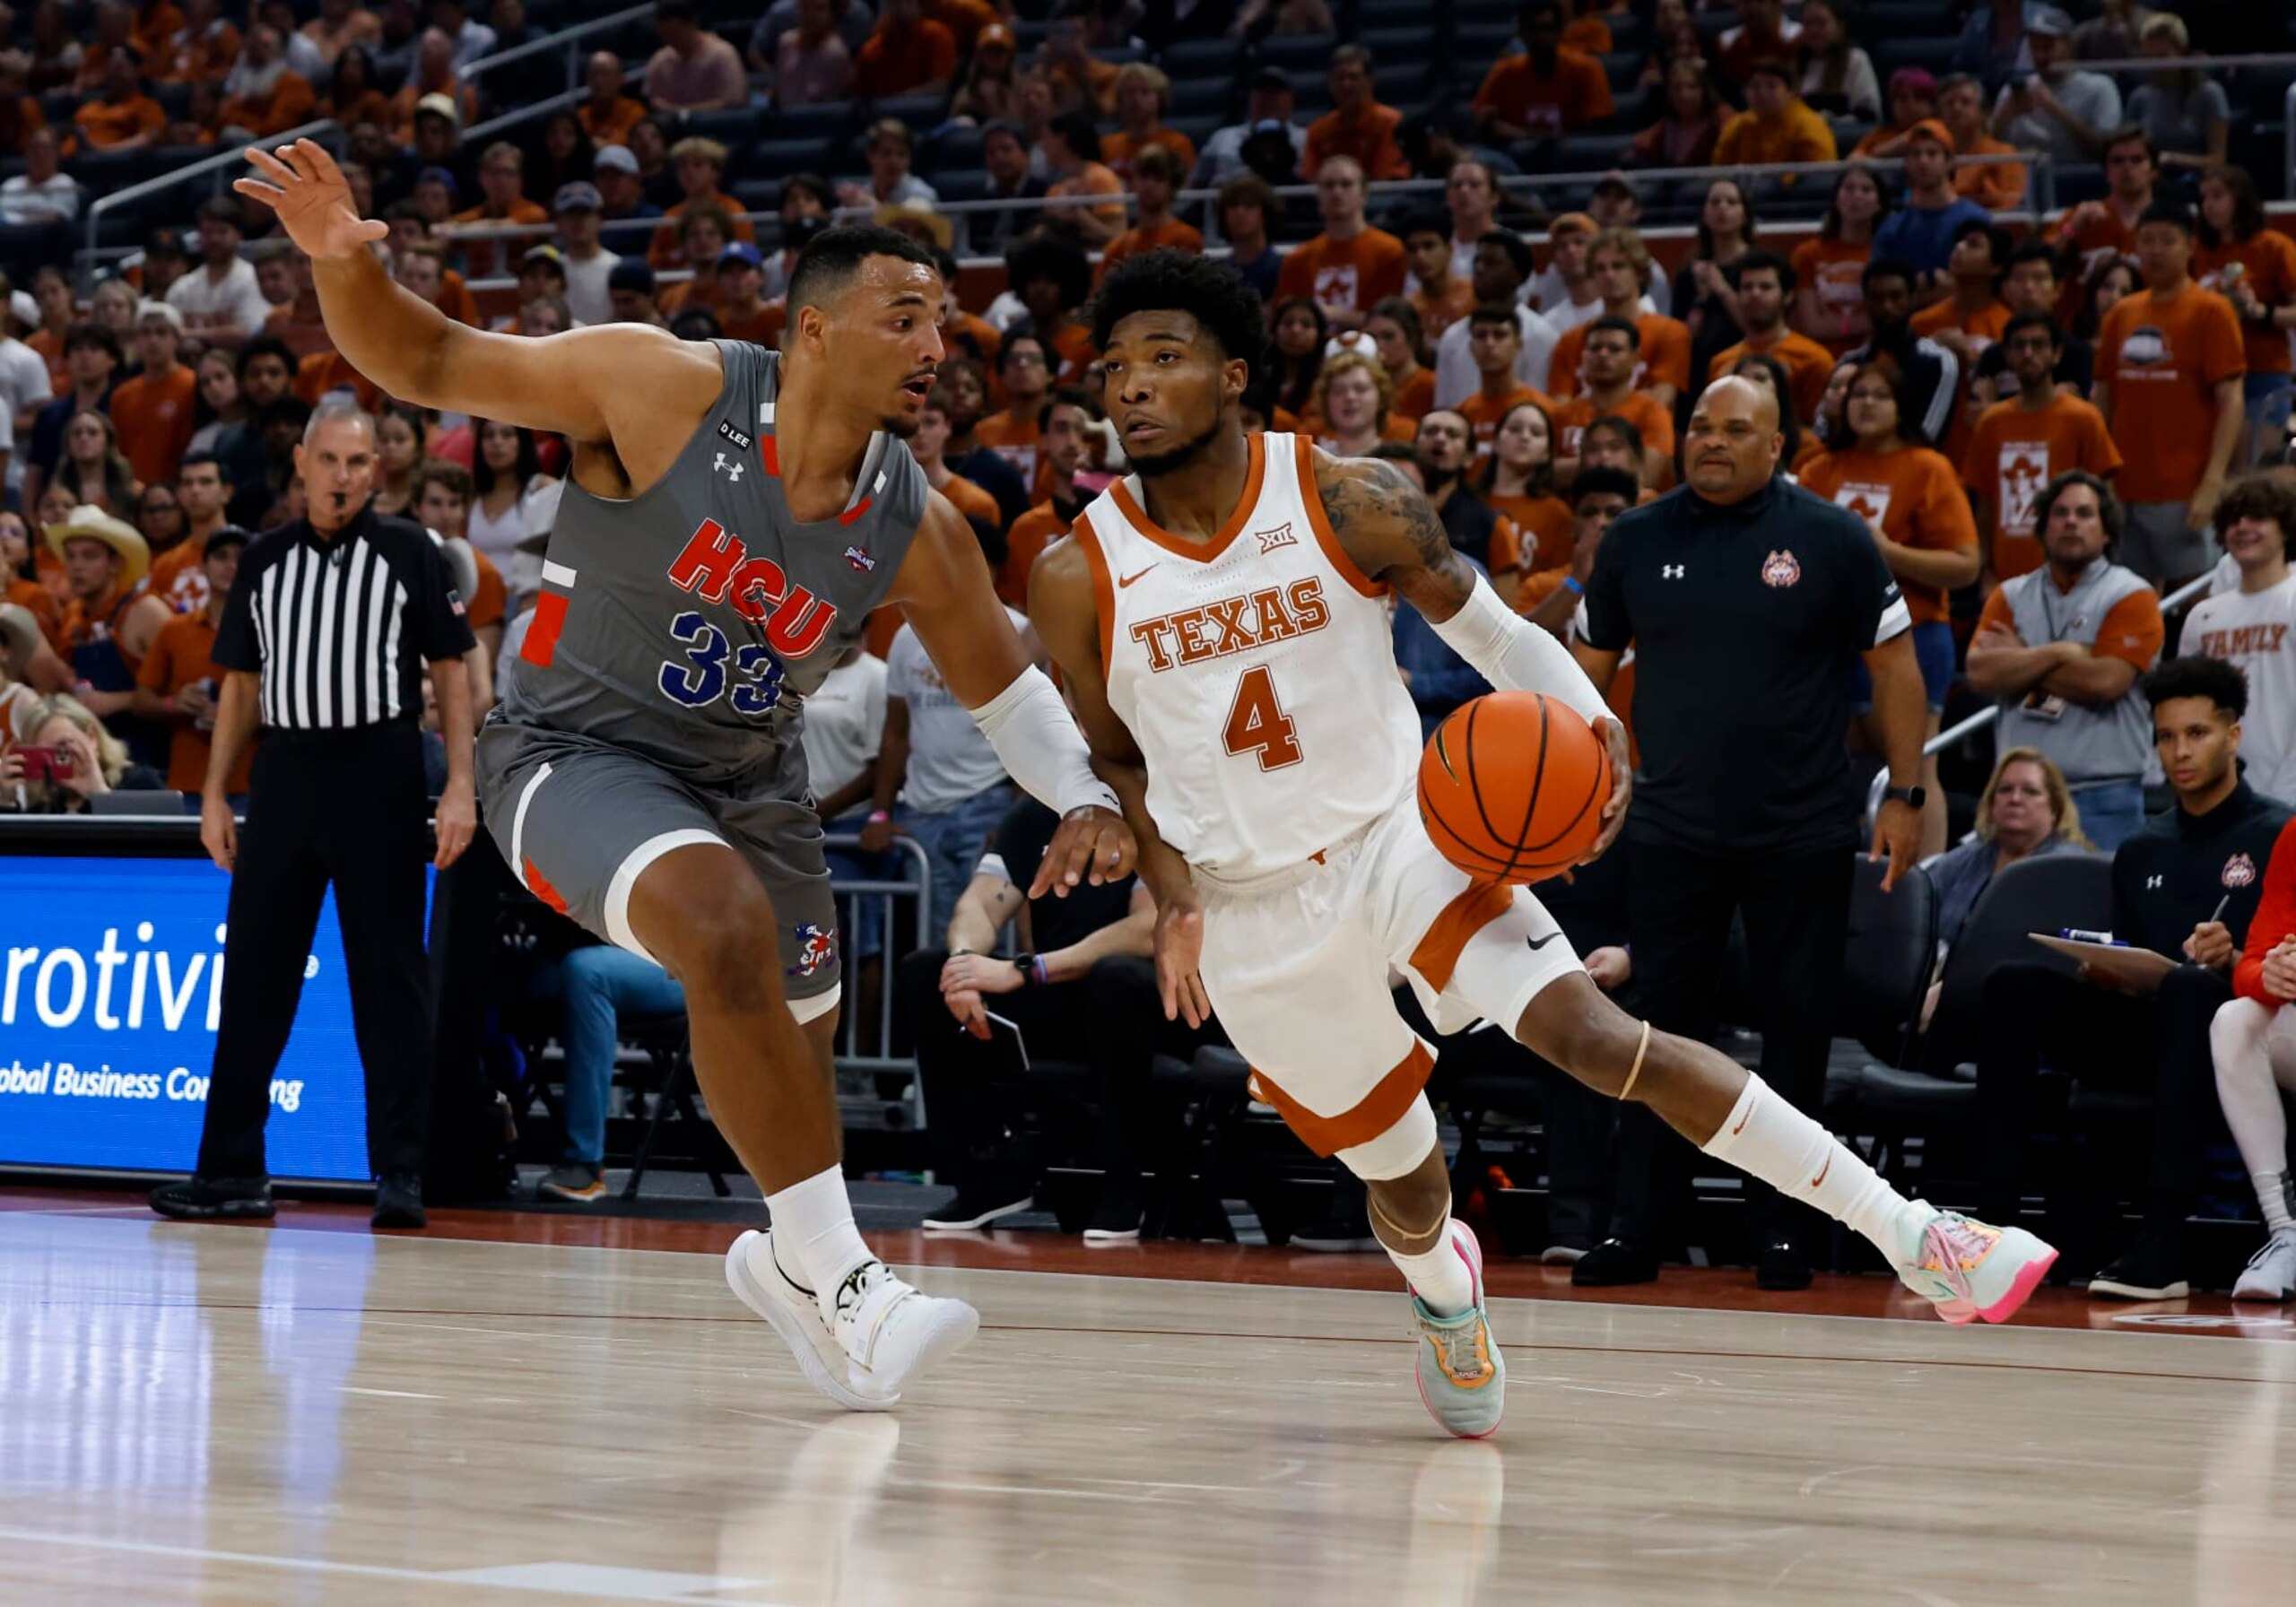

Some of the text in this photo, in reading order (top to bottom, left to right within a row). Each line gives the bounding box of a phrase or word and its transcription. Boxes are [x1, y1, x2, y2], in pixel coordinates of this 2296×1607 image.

[720, 422, 751, 447] D LEE
[667, 517, 837, 659] HCU
[1129, 576, 1330, 673] TEXAS
[658, 612, 785, 714] 33
[1222, 665, 1303, 772] 4
[53, 1062, 162, 1099] Business
